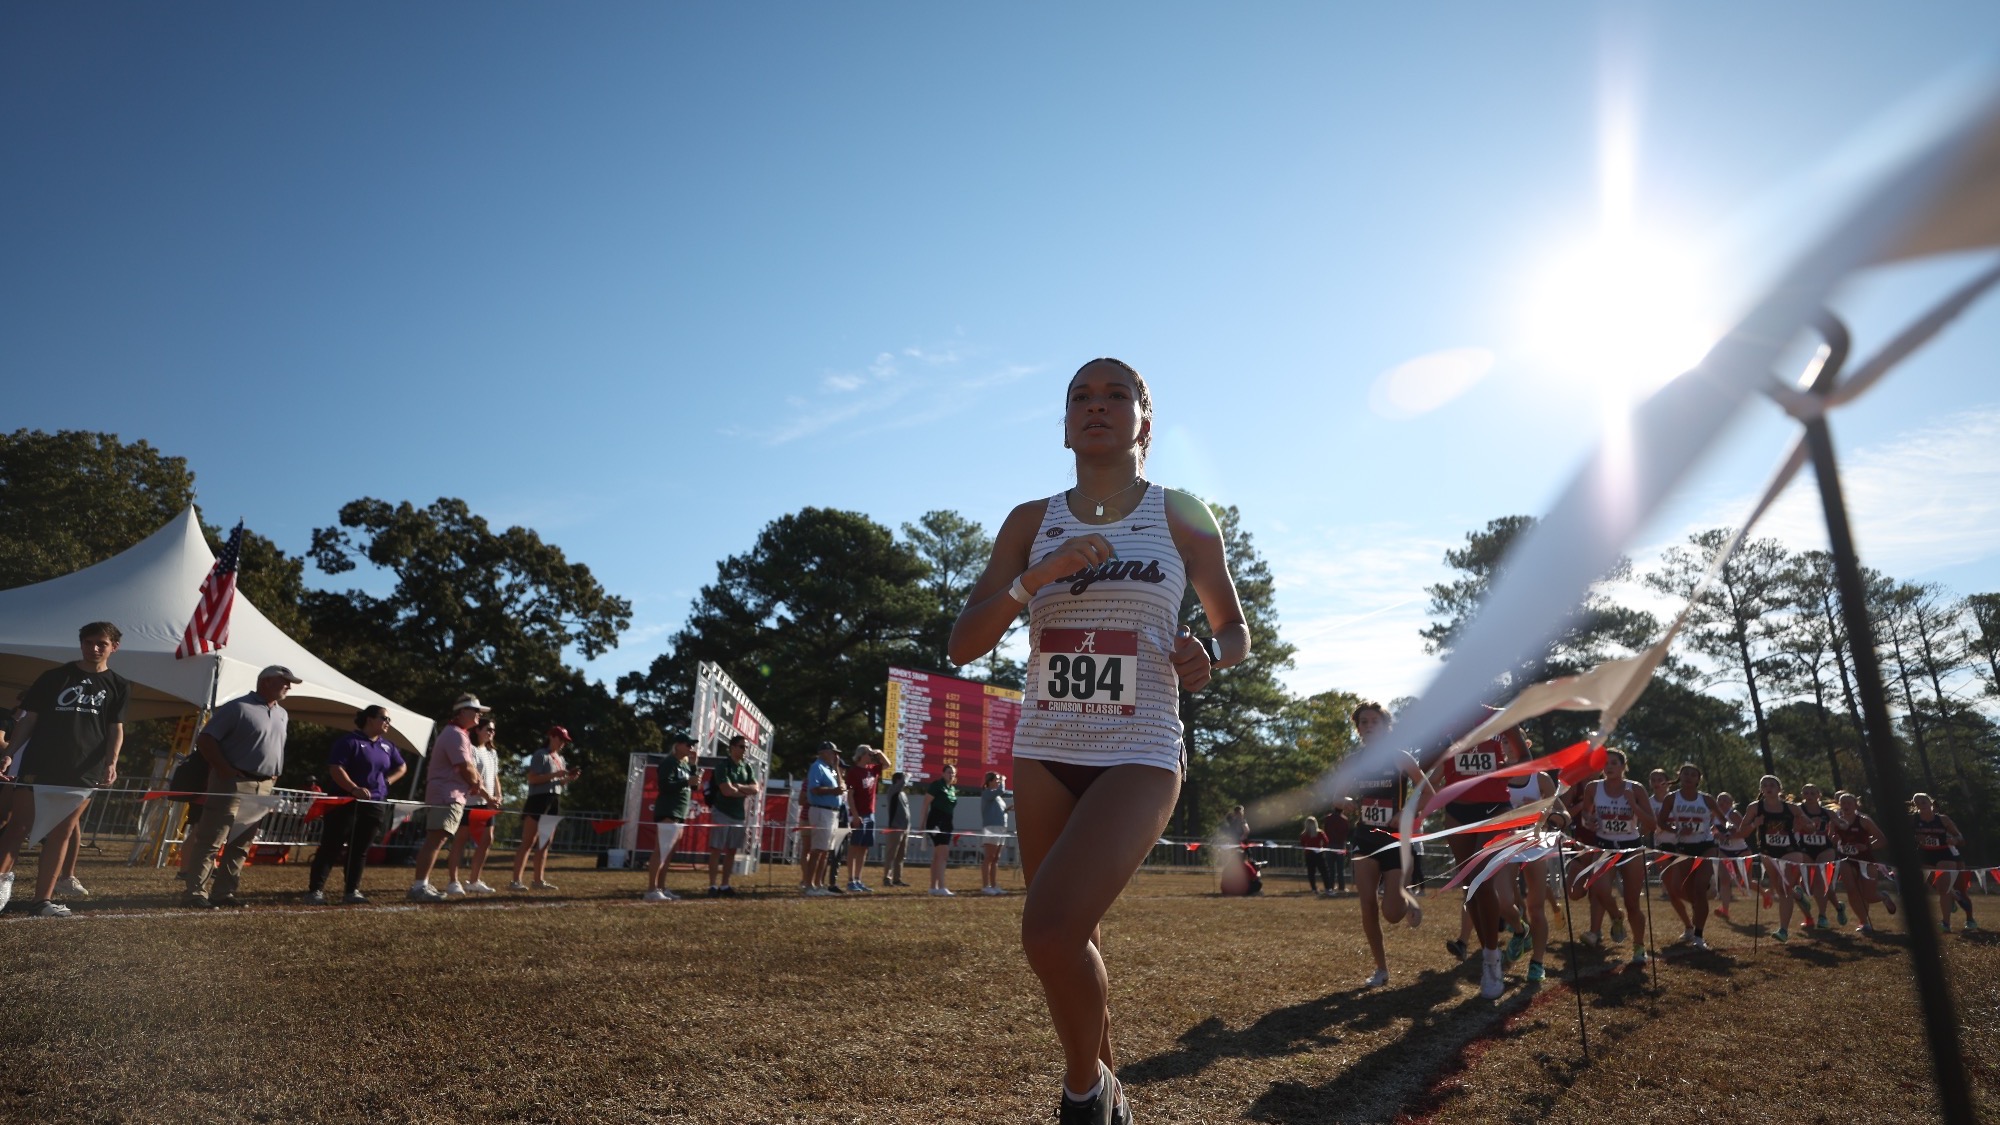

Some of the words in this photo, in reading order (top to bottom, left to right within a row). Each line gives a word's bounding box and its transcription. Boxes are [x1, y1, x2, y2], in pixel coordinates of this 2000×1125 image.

[1075, 631, 1096, 653] A
[1048, 654, 1124, 701] 394
[57, 685, 107, 707] Owls
[1048, 701, 1083, 713] CRIMSON
[1085, 704, 1123, 715] CLASSIC
[736, 709, 758, 741] FINISH
[1460, 754, 1492, 770] 448
[1364, 807, 1387, 822] 481
[1605, 821, 1629, 832] 432
[1768, 834, 1787, 844] 387
[1806, 834, 1822, 844] 411
